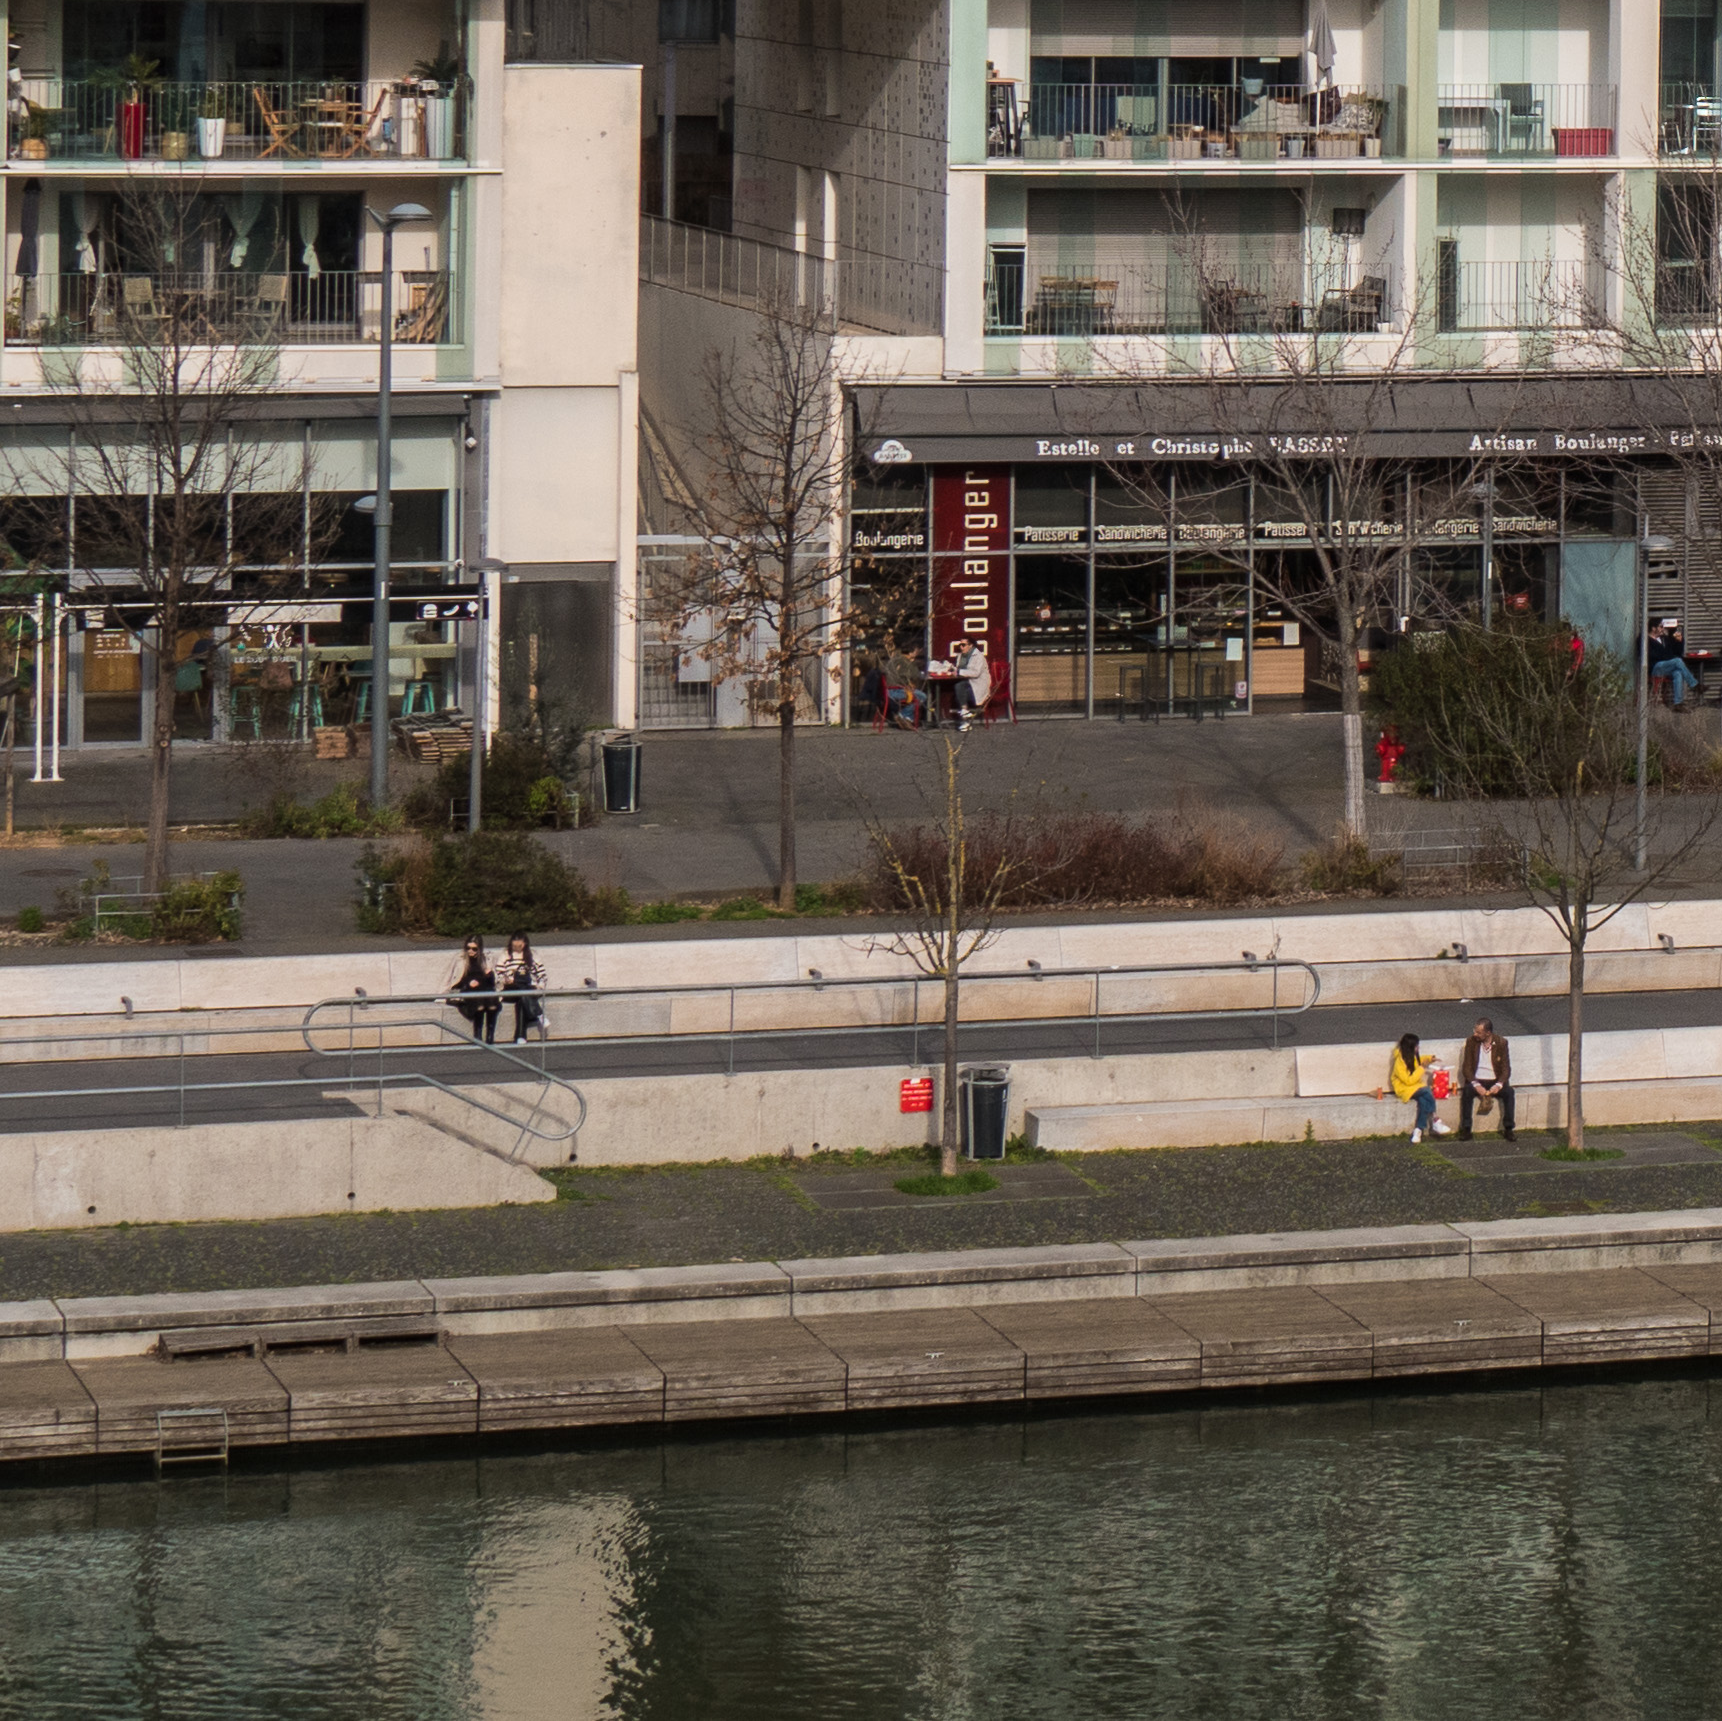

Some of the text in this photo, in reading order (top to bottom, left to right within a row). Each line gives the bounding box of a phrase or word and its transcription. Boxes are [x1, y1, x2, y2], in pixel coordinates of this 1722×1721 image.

[1036, 439, 1100, 456] Estelle
[1117, 442, 1135, 455] et
[1151, 438, 1253, 460] Christophe
[1469, 434, 1538, 451] Artisan
[1554, 433, 1647, 453] Boulanger
[855, 530, 924, 549] Boulangerie
[1097, 524, 1168, 540] Sandwicherie
